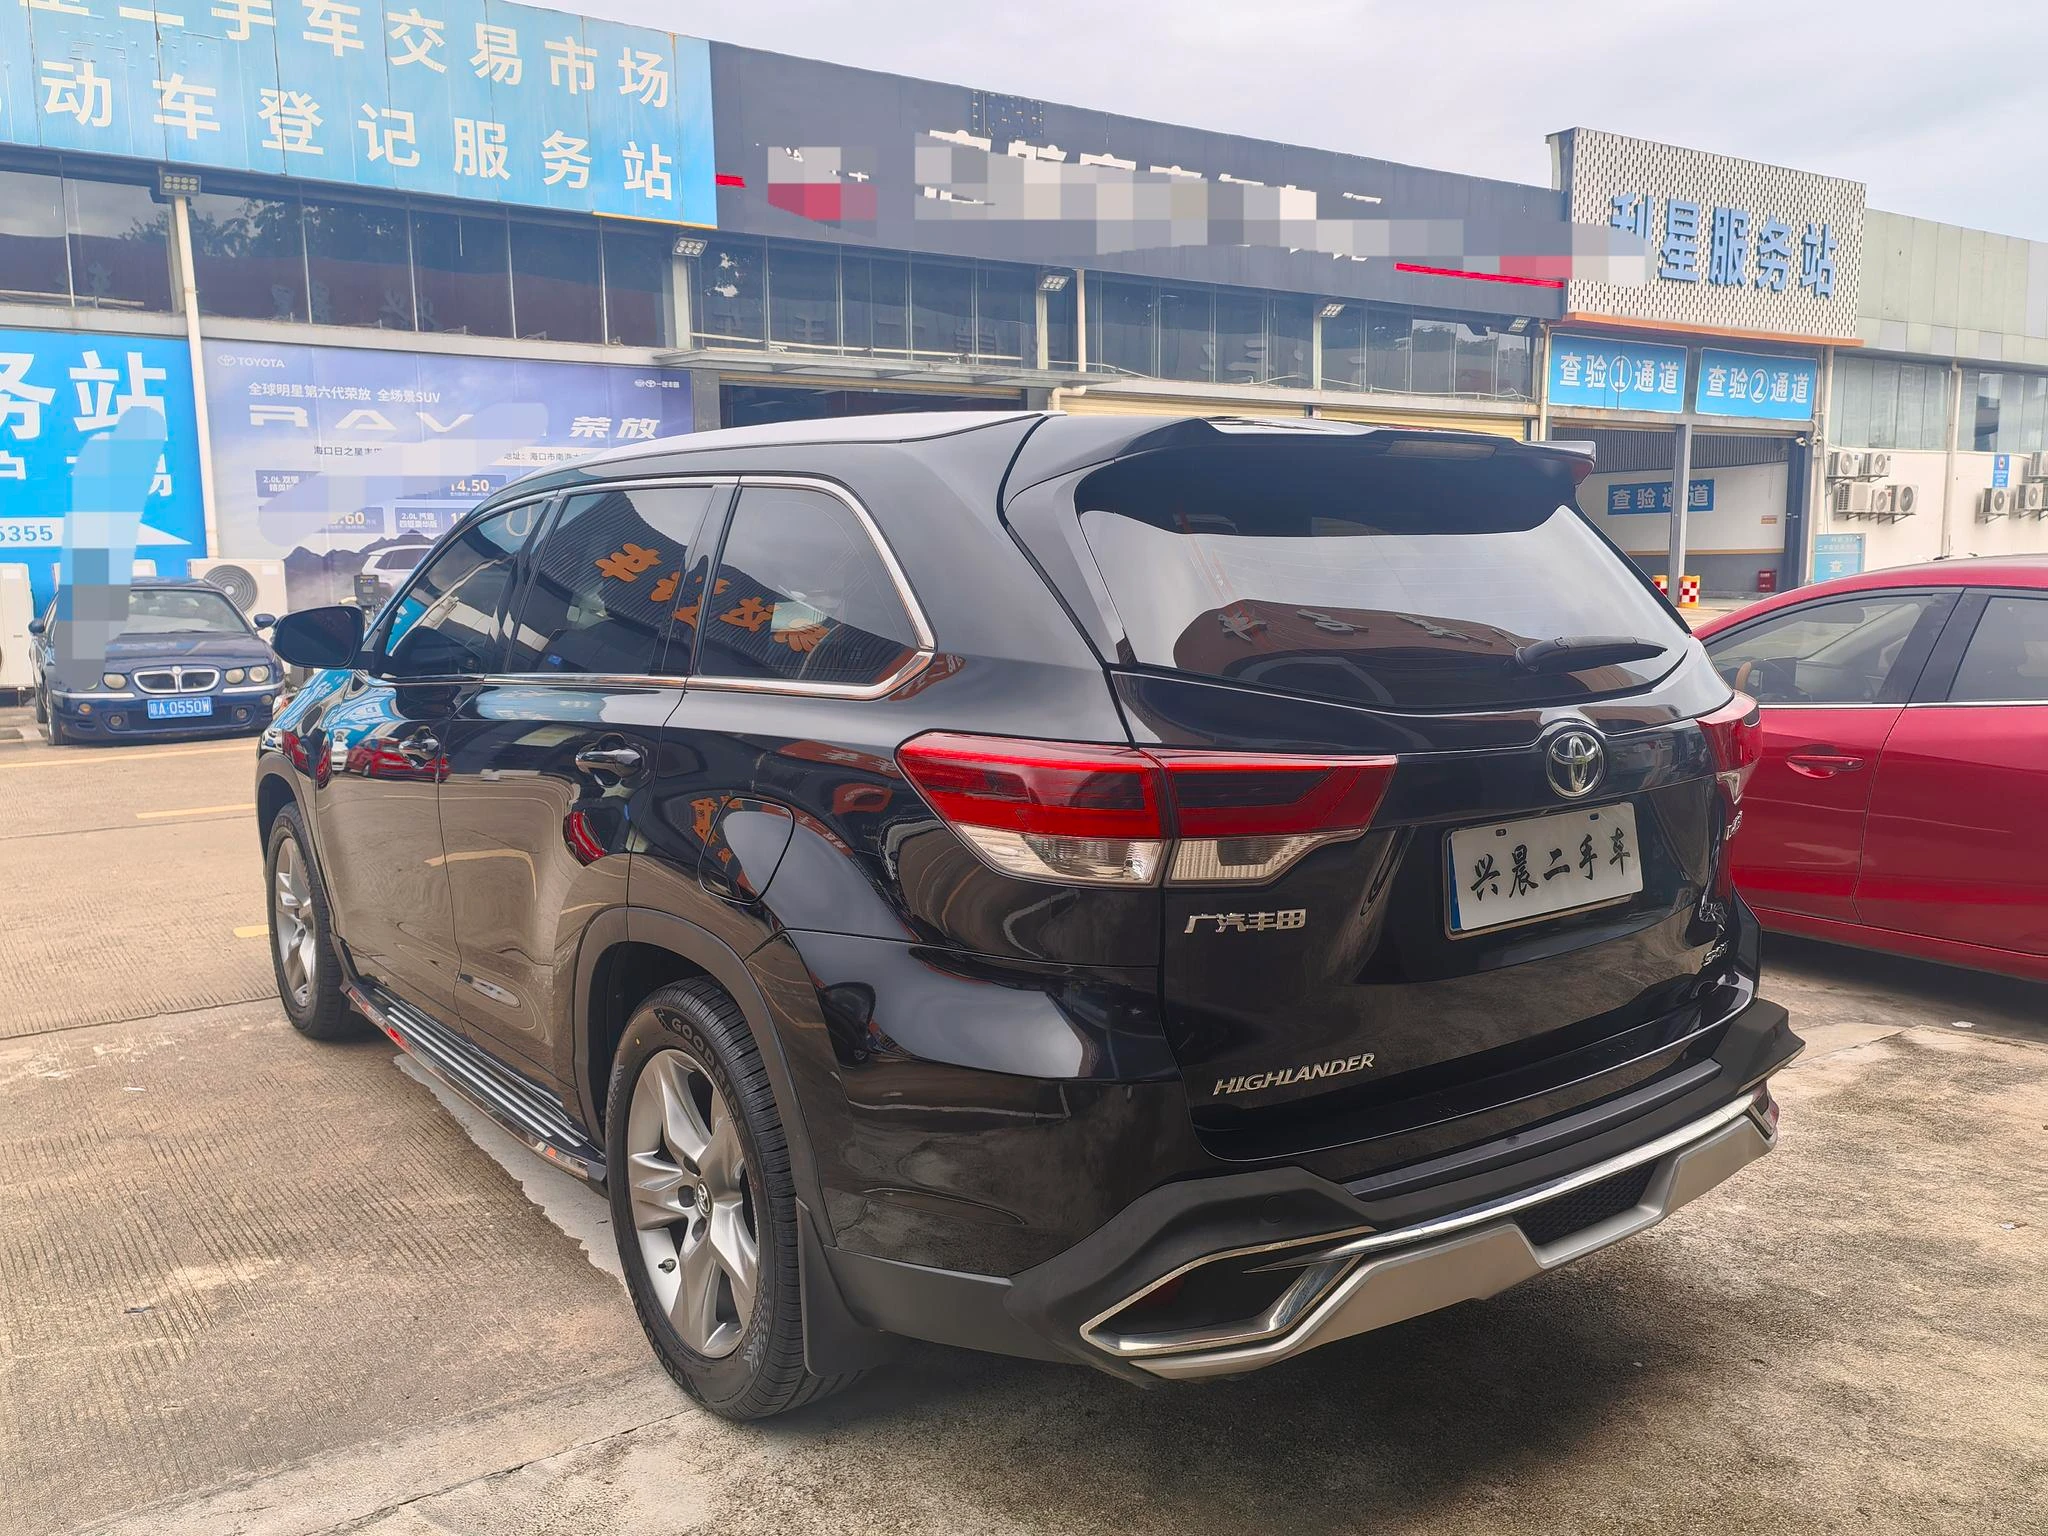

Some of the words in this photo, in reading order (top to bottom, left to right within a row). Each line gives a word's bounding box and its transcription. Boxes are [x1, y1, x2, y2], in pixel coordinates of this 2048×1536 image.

[238, 357, 286, 369] TOYOTA
[248, 382, 372, 402] 全球明星第六代荣放
[377, 388, 440, 404] 全场景SUV
[569, 415, 661, 439] 荣放
[1470, 826, 1631, 902] 兴晨二手车
[1184, 908, 1307, 935] 广汽丰田
[1212, 1052, 1376, 1096] HIGHLANDER
